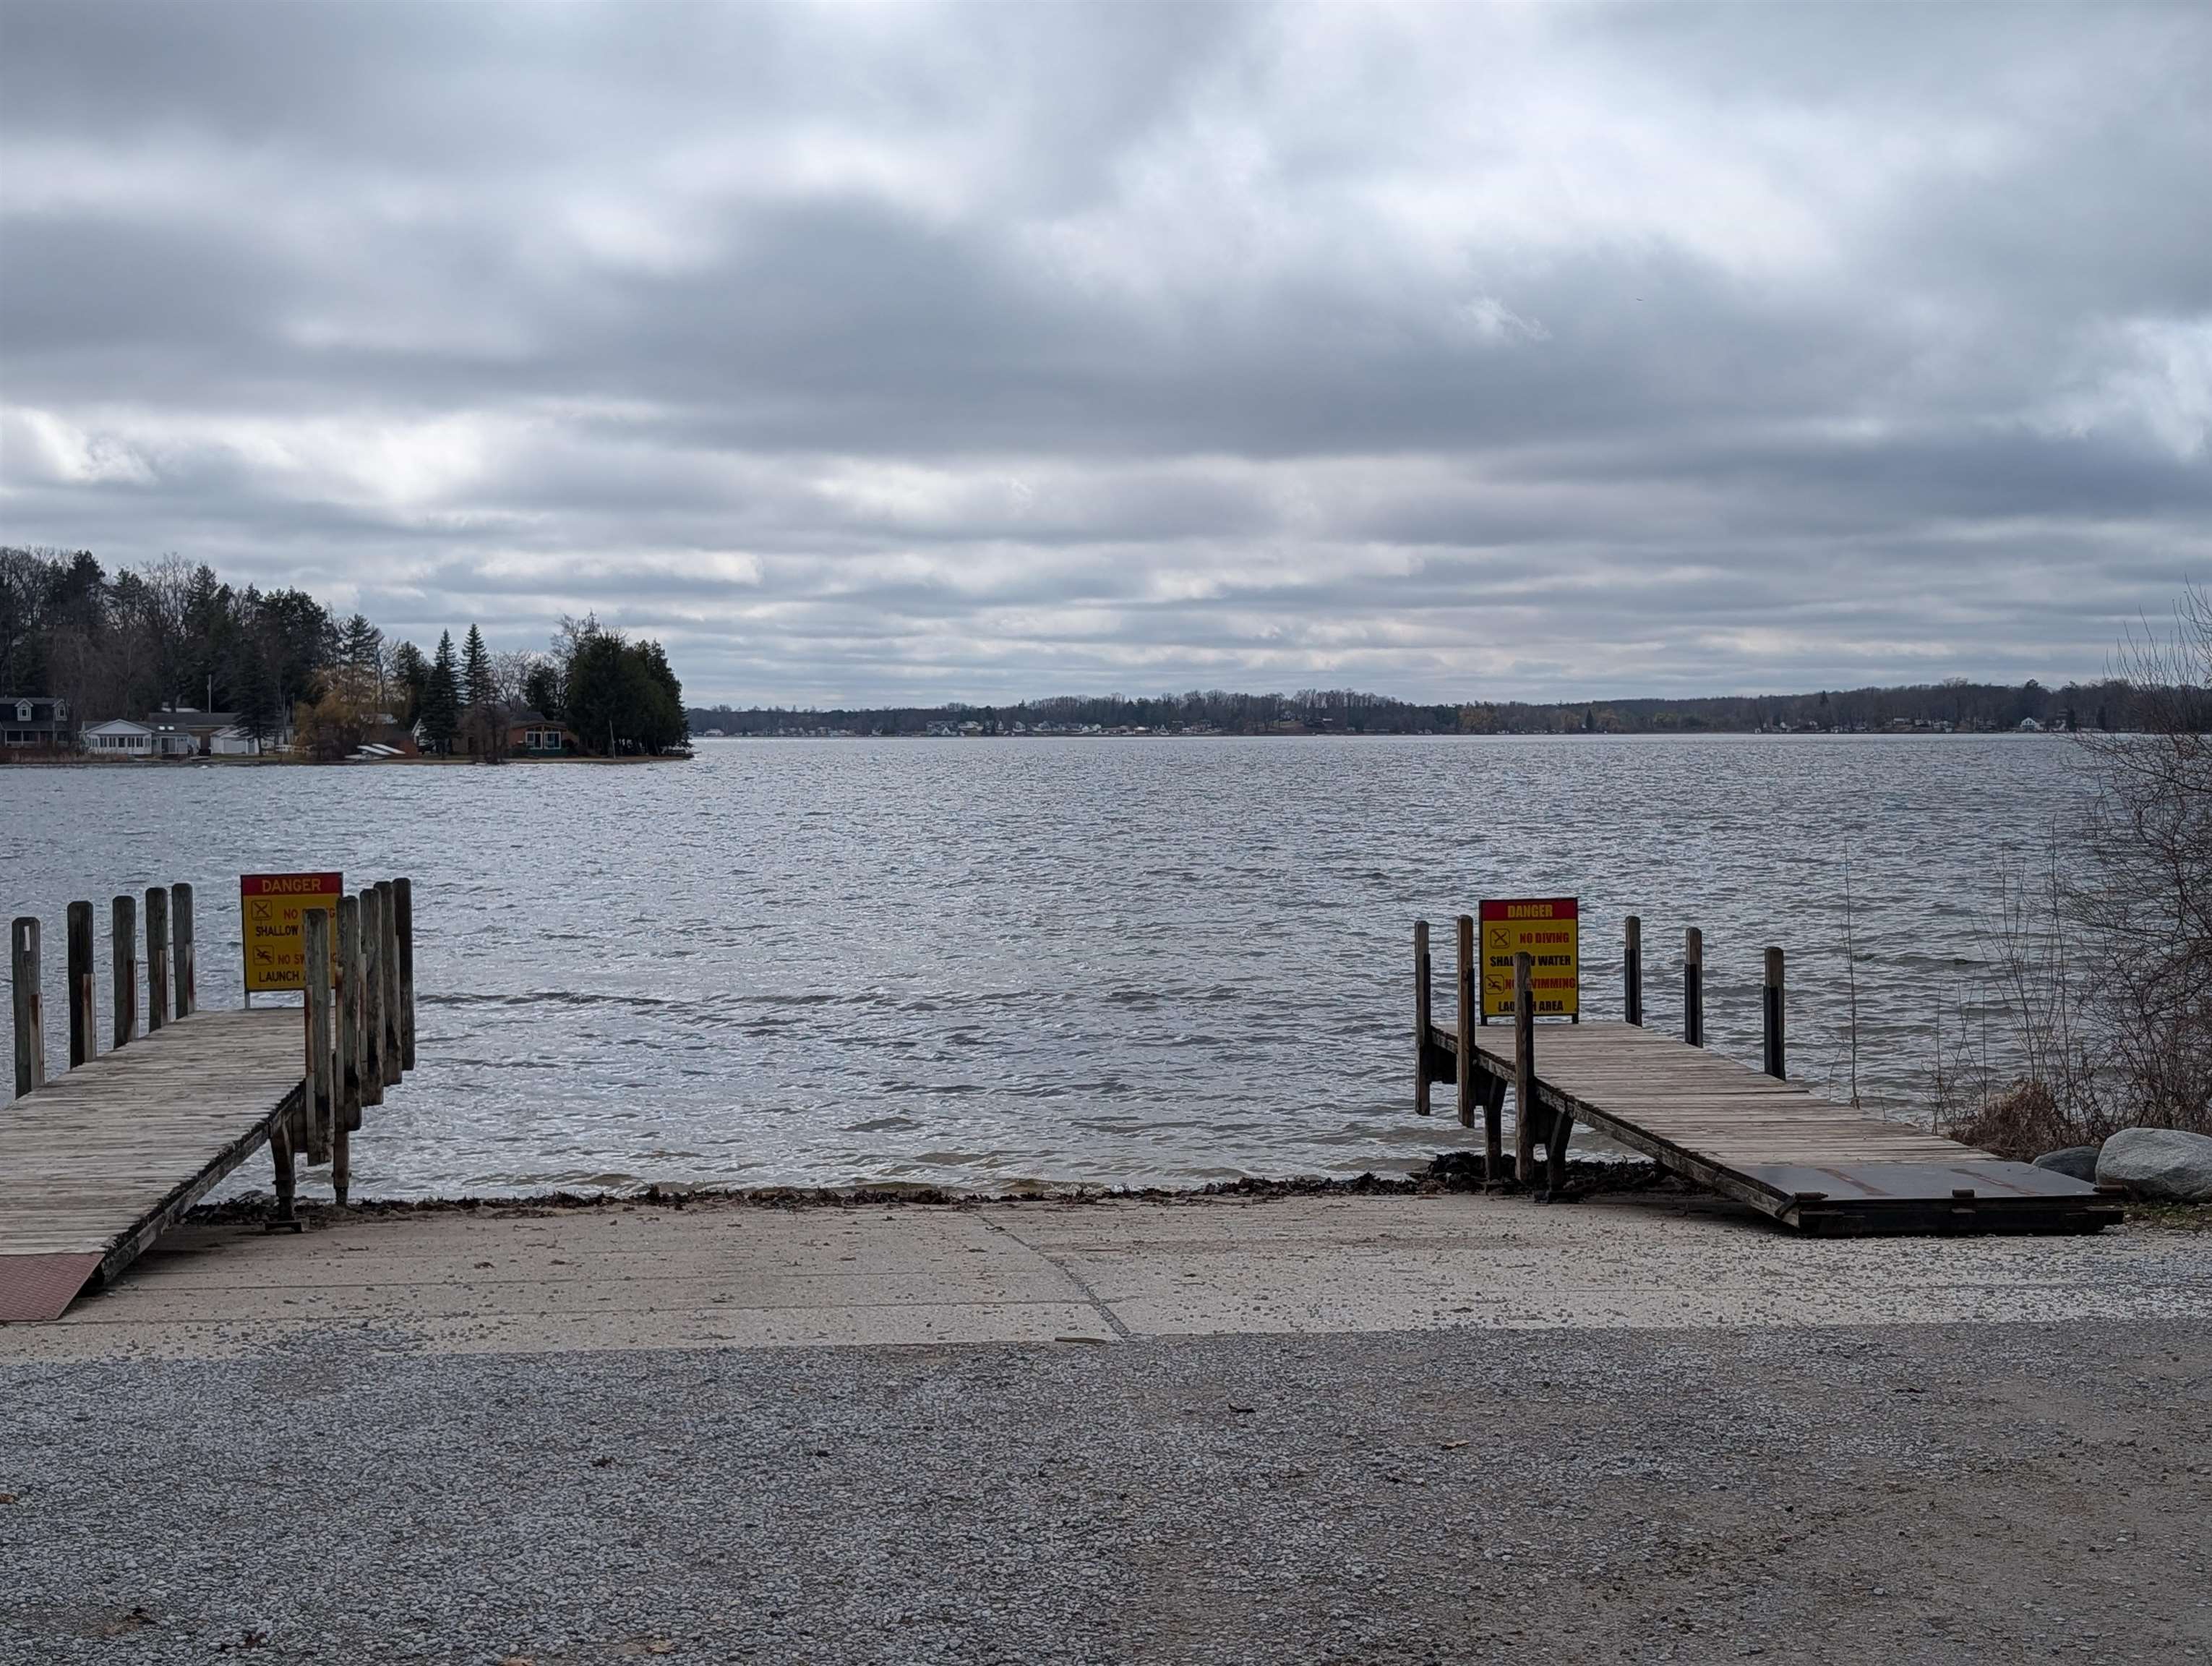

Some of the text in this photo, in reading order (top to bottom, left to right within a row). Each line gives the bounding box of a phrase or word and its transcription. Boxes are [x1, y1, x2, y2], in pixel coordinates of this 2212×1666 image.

[262, 879, 321, 892] DANGER
[283, 908, 299, 919] NO
[1507, 905, 1553, 918] DANGER
[256, 925, 299, 937] SHALLOW
[1519, 932, 1569, 944] NO DIVING
[278, 954, 290, 965] NO
[1490, 955, 1571, 967] SHALW WATER
[259, 971, 299, 982] LAUNCH
[1498, 1000, 1564, 1012] LAUH AREA
